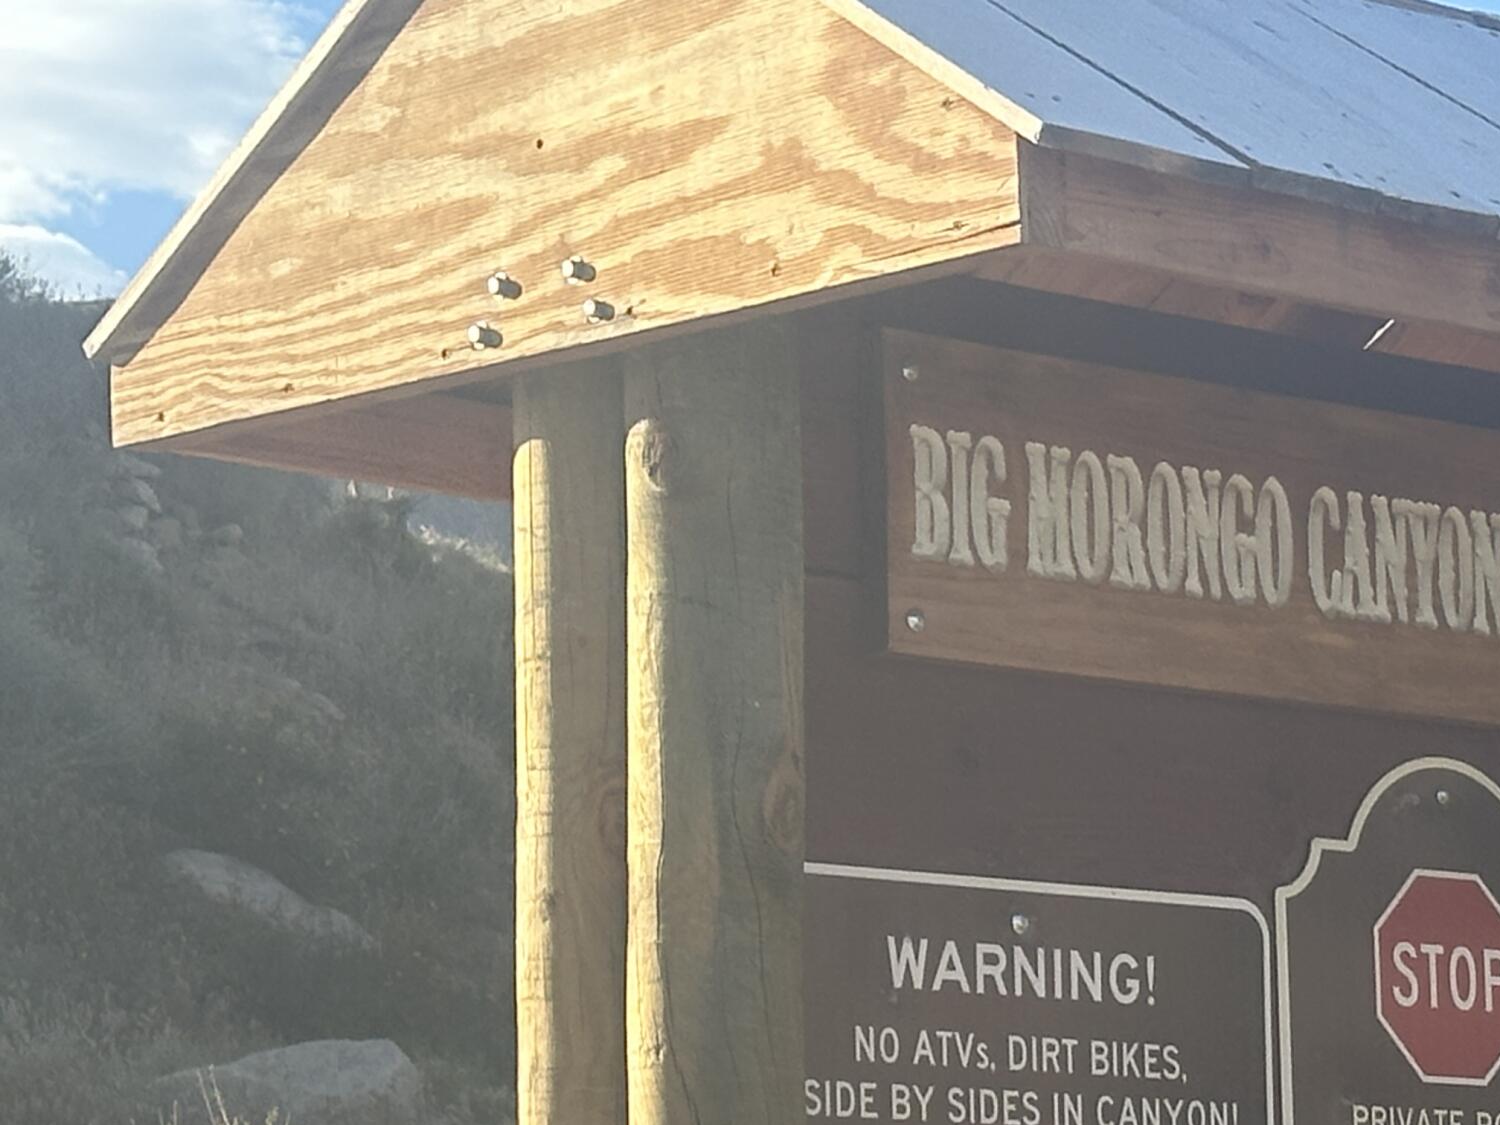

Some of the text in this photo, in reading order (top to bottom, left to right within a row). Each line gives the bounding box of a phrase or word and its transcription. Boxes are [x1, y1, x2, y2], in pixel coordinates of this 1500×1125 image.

[909, 423, 1011, 573] BIG
[1024, 441, 1295, 607] MORONGO
[887, 935, 1157, 1006] WARNING!
[854, 1025, 1188, 1084] NO ATVs, DIRT BIKES,
[804, 1080, 878, 1119] SIDE
[891, 1083, 935, 1122] BY
